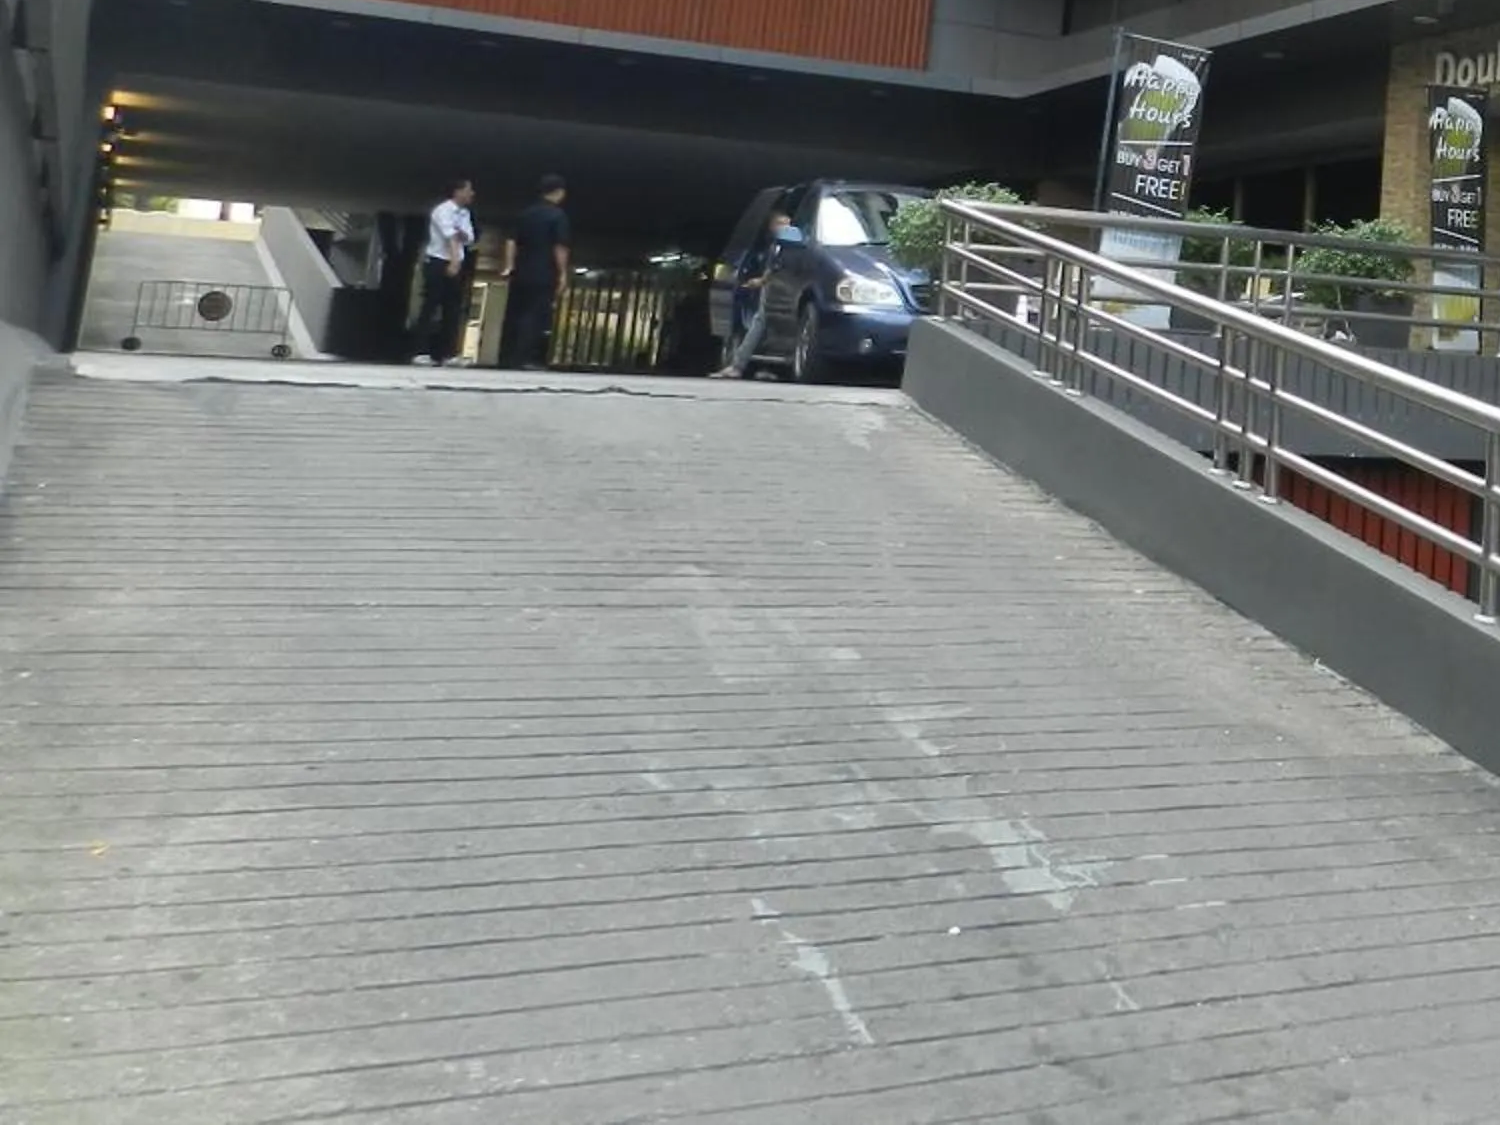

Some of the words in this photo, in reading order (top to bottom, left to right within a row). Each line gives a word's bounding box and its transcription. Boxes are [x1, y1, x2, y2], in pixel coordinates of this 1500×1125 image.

[1130, 87, 1192, 128] Hours
[1117, 150, 1142, 167] BUY
[1157, 158, 1181, 174] GET
[1436, 136, 1480, 162] Hours
[1135, 174, 1187, 201] FREE!
